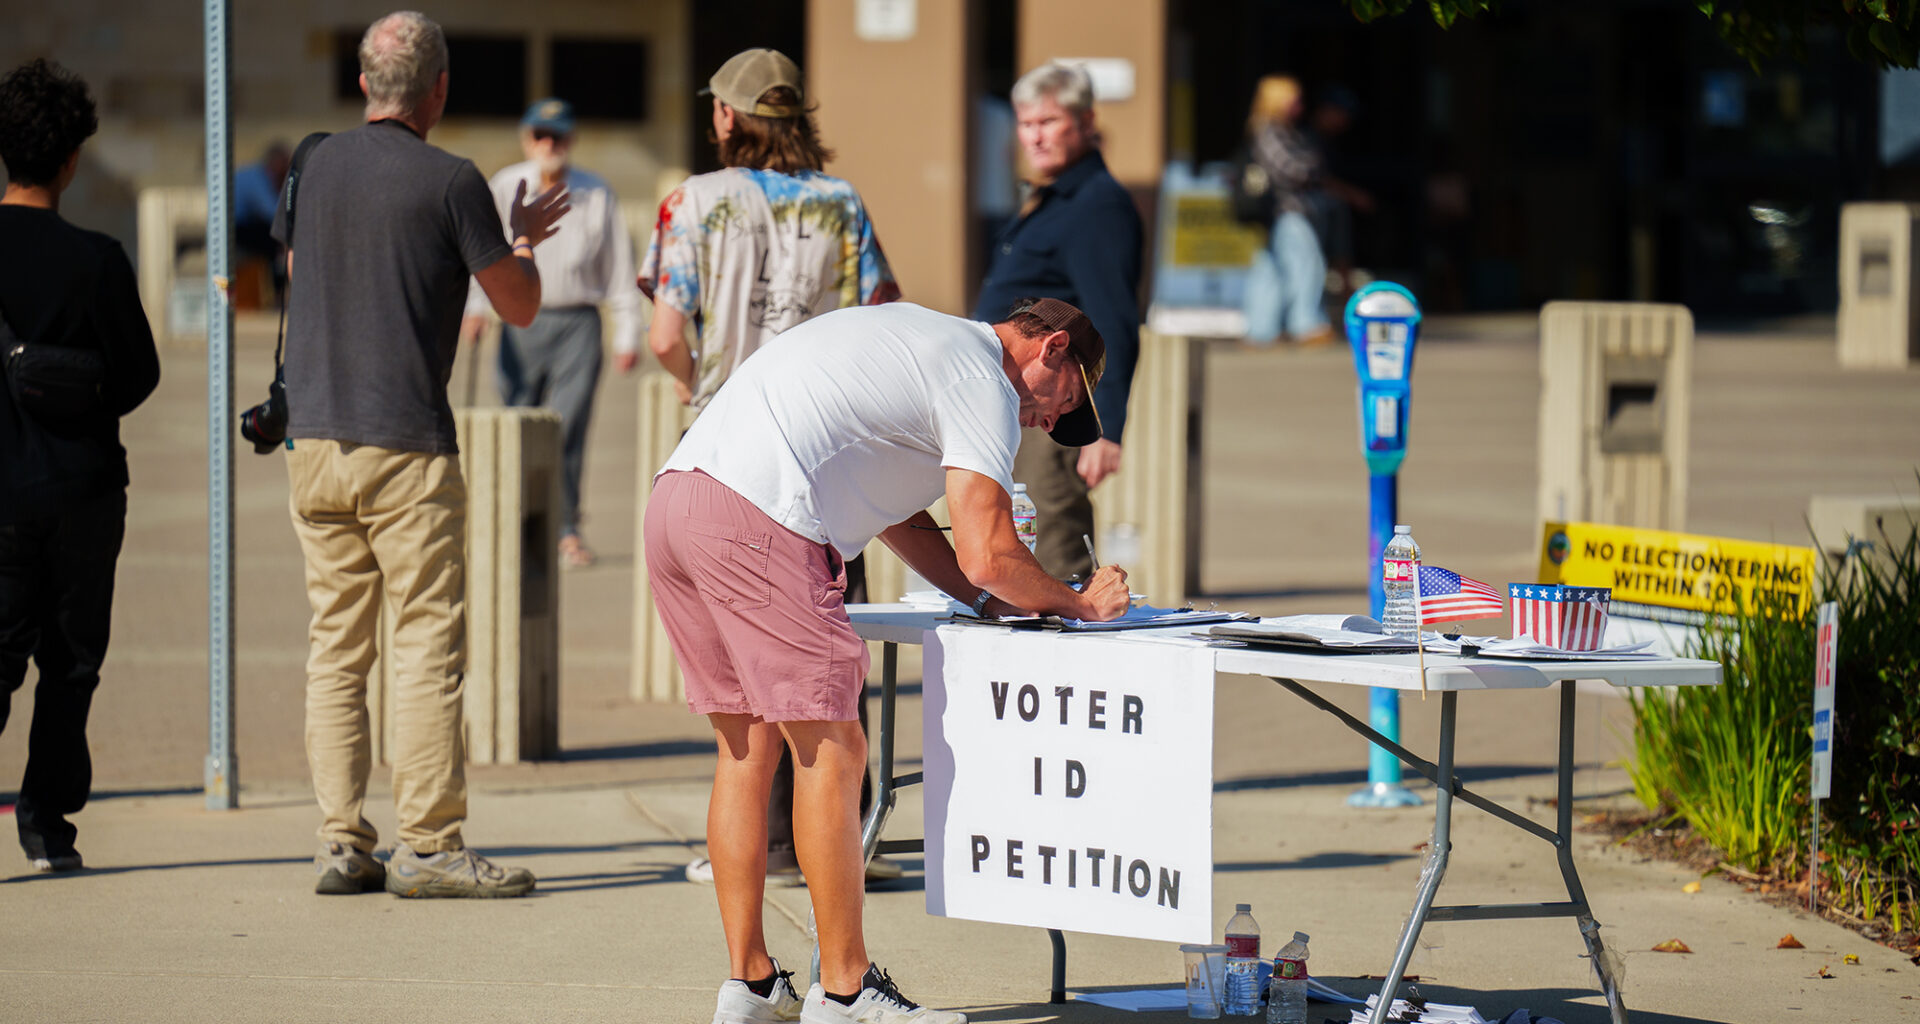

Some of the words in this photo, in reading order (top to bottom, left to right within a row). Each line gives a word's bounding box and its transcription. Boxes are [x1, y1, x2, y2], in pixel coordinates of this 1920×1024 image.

[1584, 541, 1614, 561] NO
[1614, 569, 1693, 597] WITHIN
[990, 681, 1144, 735] VOTER
[1034, 757, 1087, 798] ID
[971, 834, 1181, 910] PETITION
